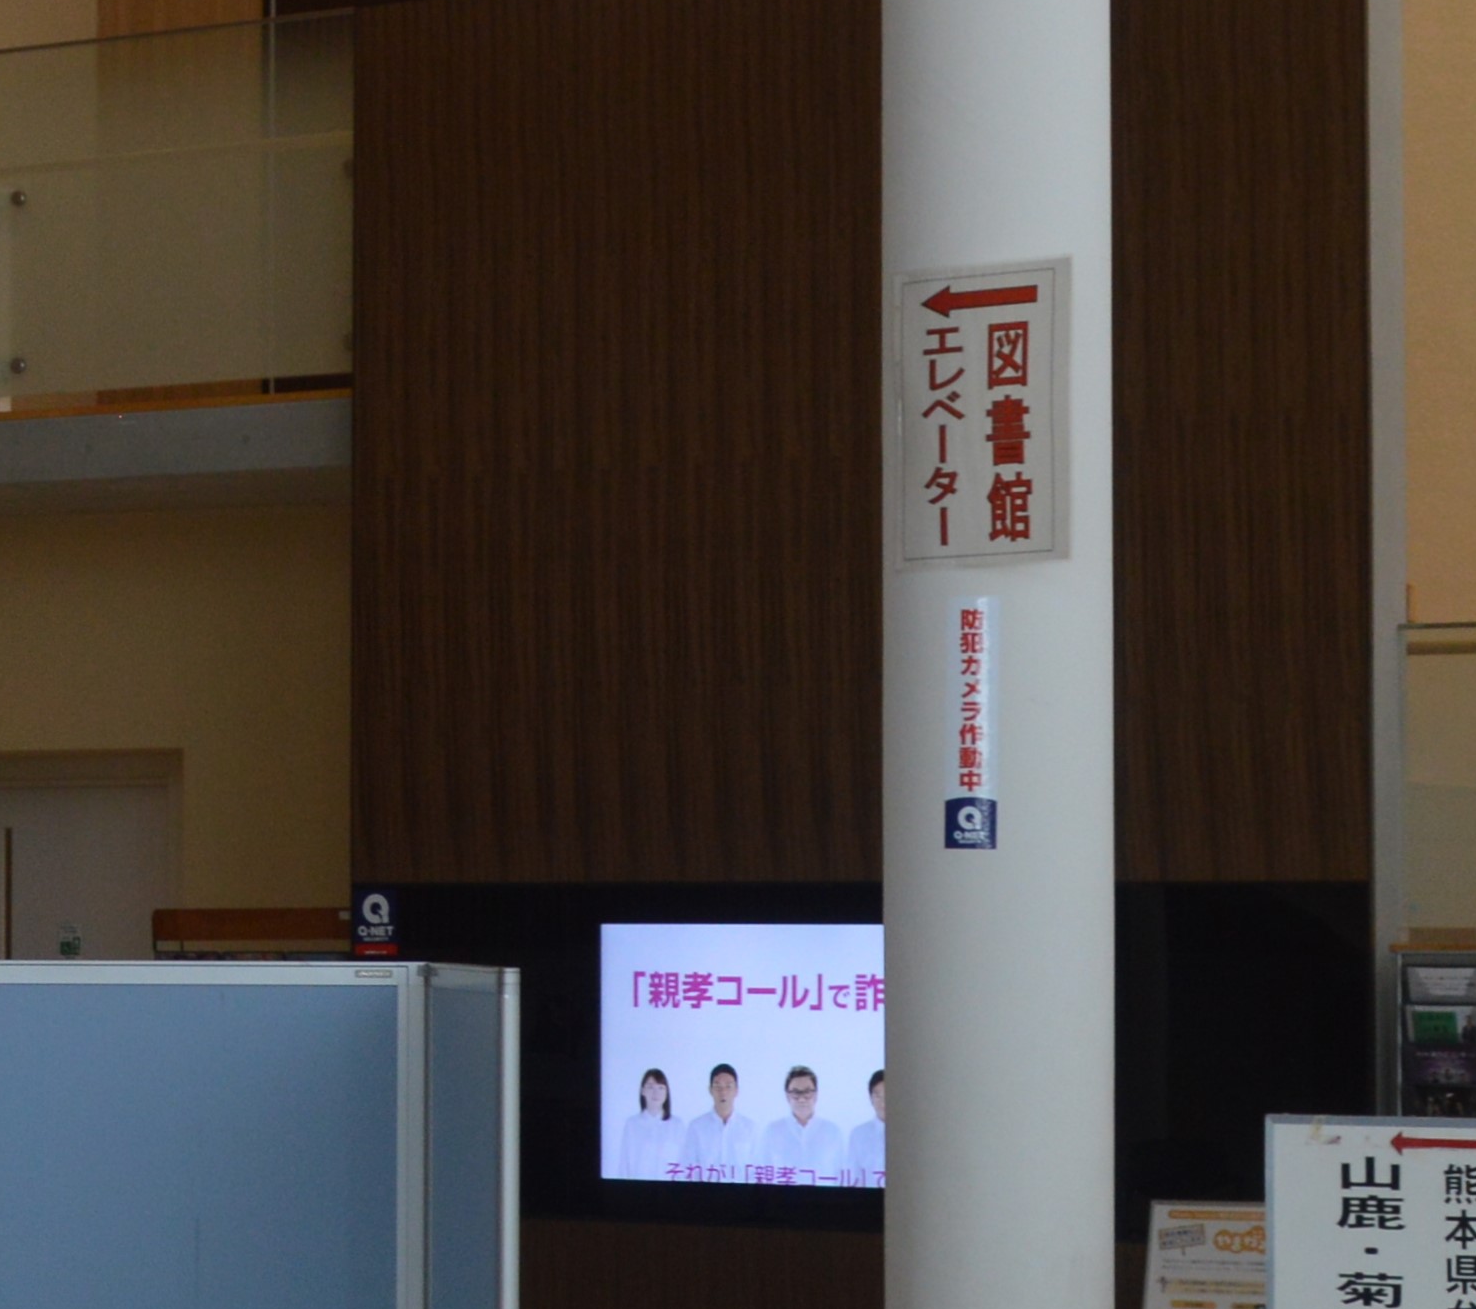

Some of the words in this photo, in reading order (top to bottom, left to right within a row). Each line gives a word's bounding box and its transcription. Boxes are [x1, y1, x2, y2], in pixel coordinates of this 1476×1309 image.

[921, 327, 966, 547] エレベーター
[985, 321, 1034, 543] 図書館
[959, 609, 984, 793] 防犯カメラ作動中
